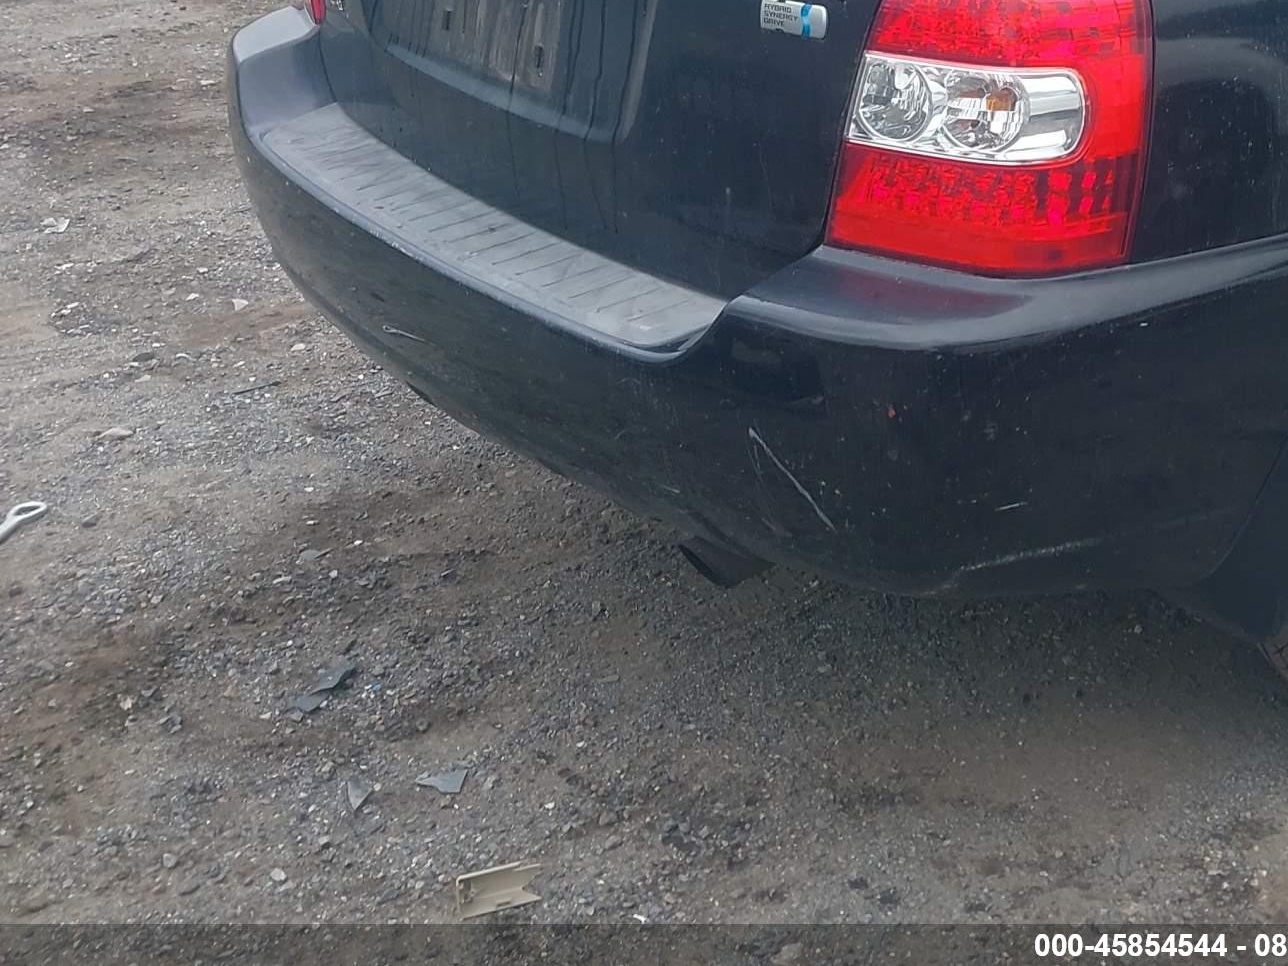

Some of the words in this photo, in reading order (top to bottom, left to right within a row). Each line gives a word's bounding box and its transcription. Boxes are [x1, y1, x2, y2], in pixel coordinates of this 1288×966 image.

[764, 3, 792, 13] HYBRID
[764, 10, 799, 21] SYNERGY
[763, 17, 785, 26] DRIVE
